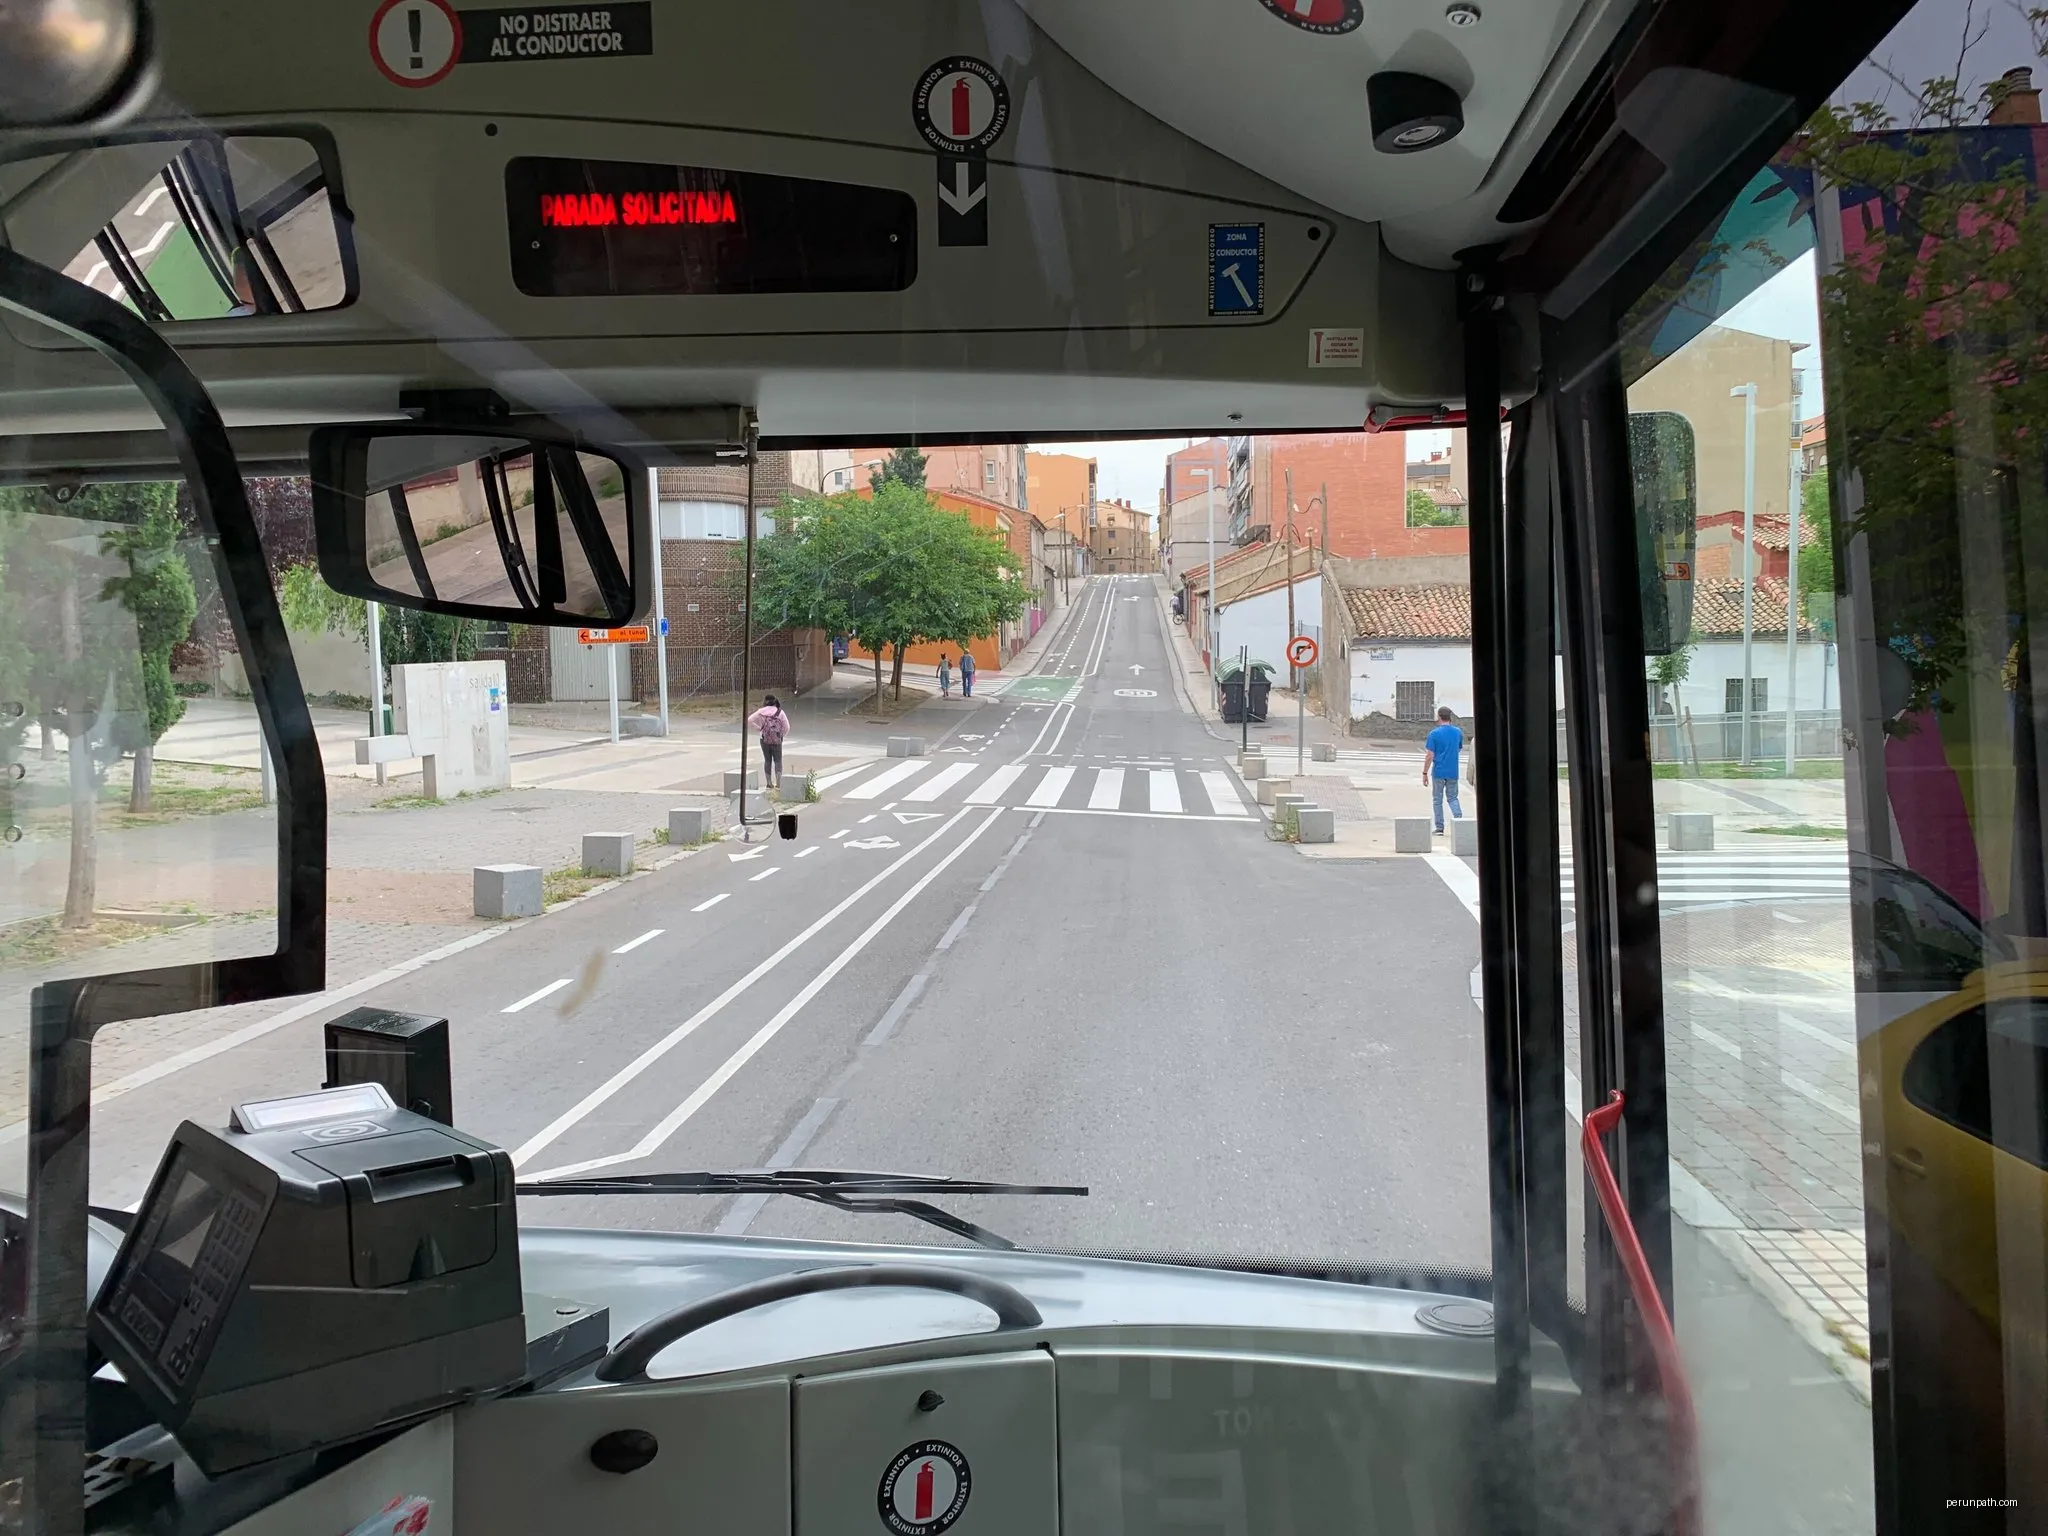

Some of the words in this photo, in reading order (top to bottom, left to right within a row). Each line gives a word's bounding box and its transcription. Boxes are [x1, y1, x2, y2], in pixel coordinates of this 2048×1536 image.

[500, 15, 529, 35] NO
[533, 11, 612, 33] DISTRAER
[490, 37, 513, 56] AL
[516, 32, 624, 56] CONDUCTOR
[960, 61, 999, 87] EXTINTOR
[918, 68, 943, 109] EXTINTOR
[980, 104, 1006, 145] EXTINTOR
[924, 126, 965, 152] EXTINTOR
[541, 193, 618, 226] PARADA
[622, 190, 736, 225] SOLICITADA
[1226, 233, 1247, 241] ZONA
[1215, 248, 1258, 257] CONDUCTOR
[926, 1444, 963, 1467] EXTINTOR
[884, 1454, 910, 1497] EXTINTOR
[942, 1481, 967, 1524] EXTINTOR
[889, 1513, 926, 1535] EXTINTOR
